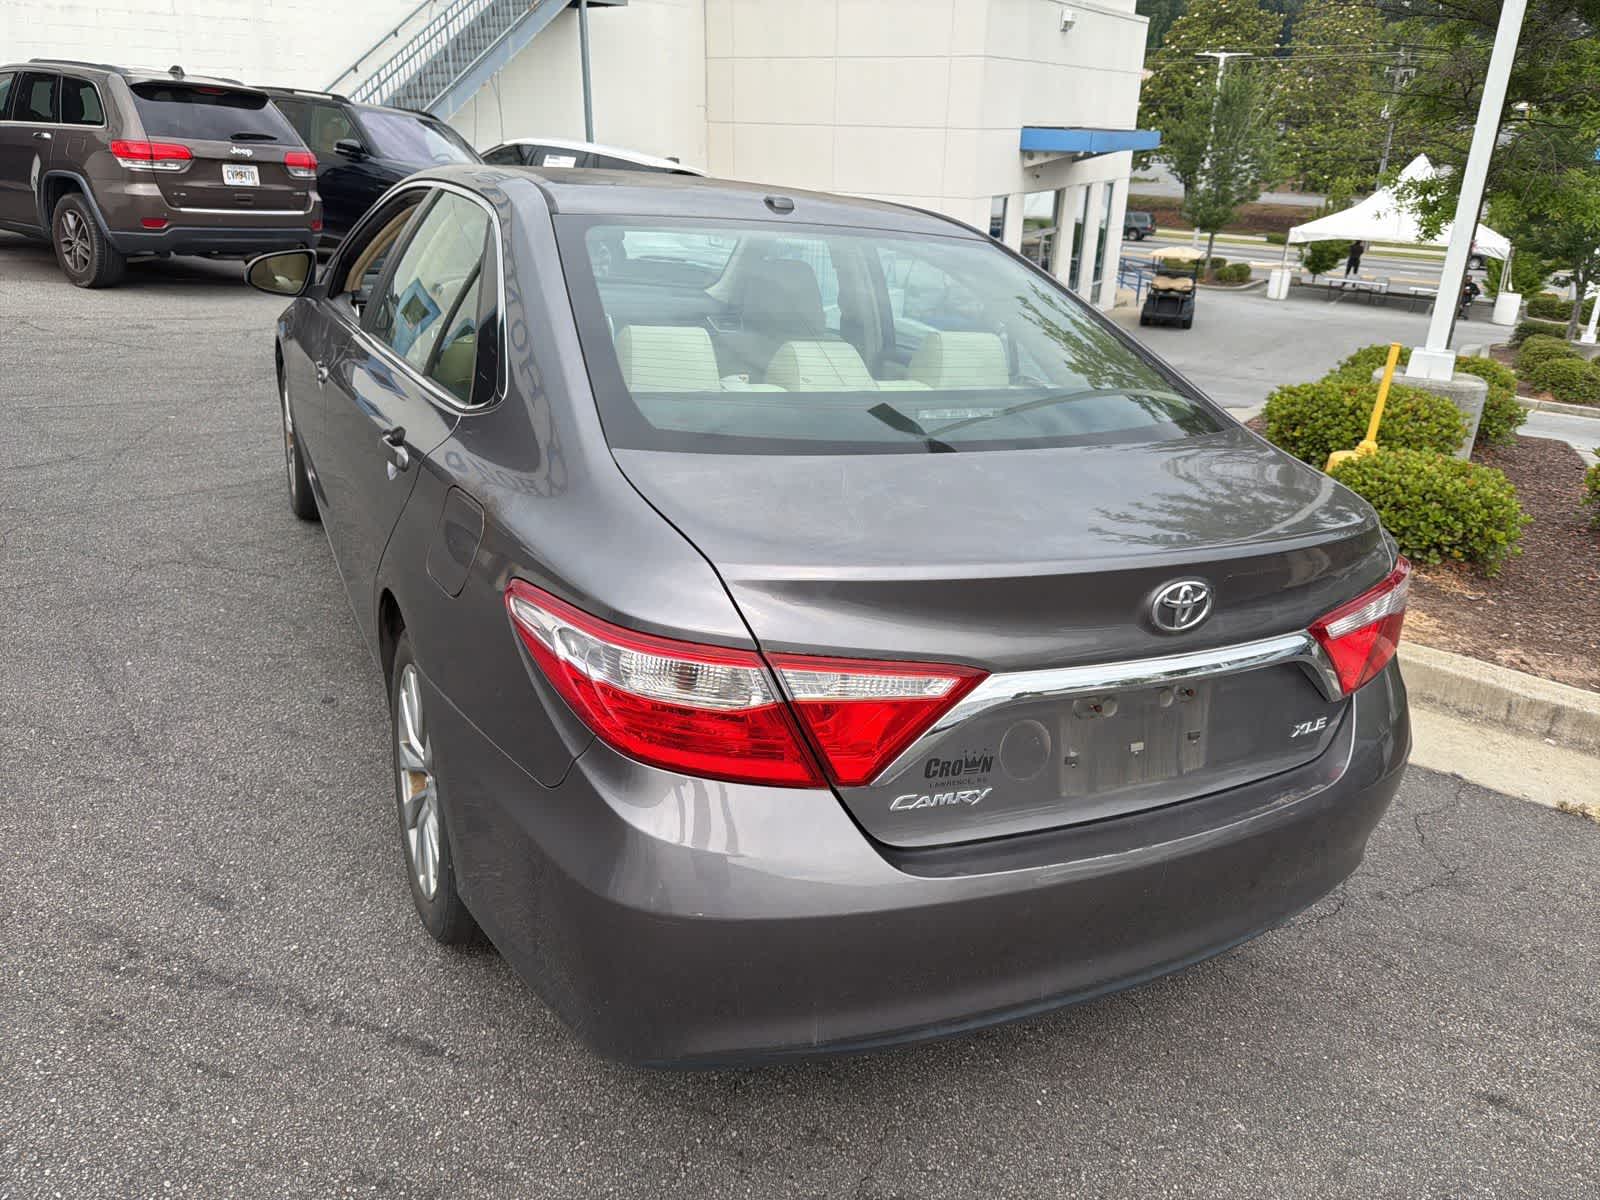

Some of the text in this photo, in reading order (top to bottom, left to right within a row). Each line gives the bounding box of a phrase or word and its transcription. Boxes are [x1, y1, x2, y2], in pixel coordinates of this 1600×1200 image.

[229, 145, 253, 158] Jeep
[1290, 716, 1328, 738] XLE
[924, 751, 994, 778] CROWN
[889, 787, 993, 811] CAMRY
